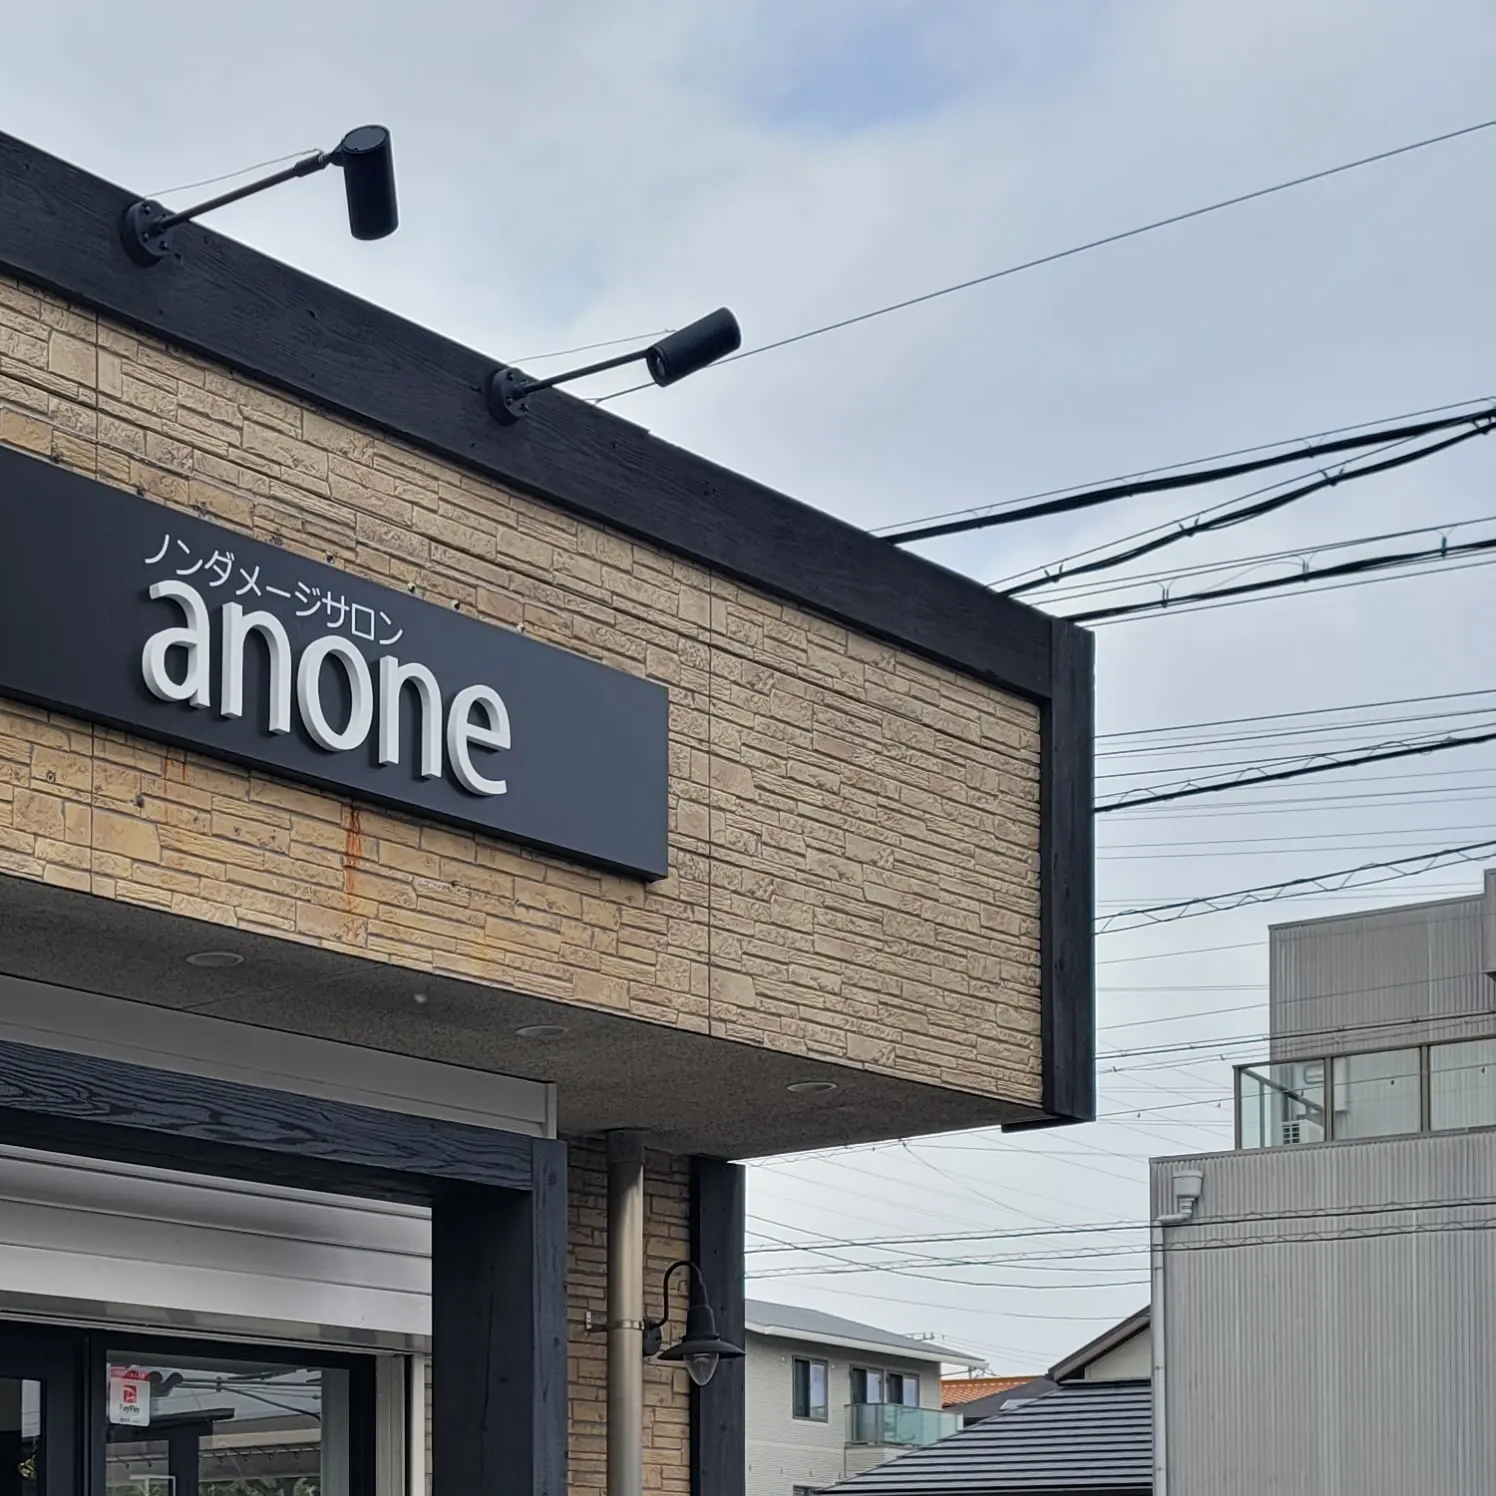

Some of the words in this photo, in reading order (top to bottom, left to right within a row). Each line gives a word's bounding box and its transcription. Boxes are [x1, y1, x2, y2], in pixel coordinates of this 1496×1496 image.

[144, 533, 404, 646] ノンダメージサロン
[141, 579, 512, 797] anone
